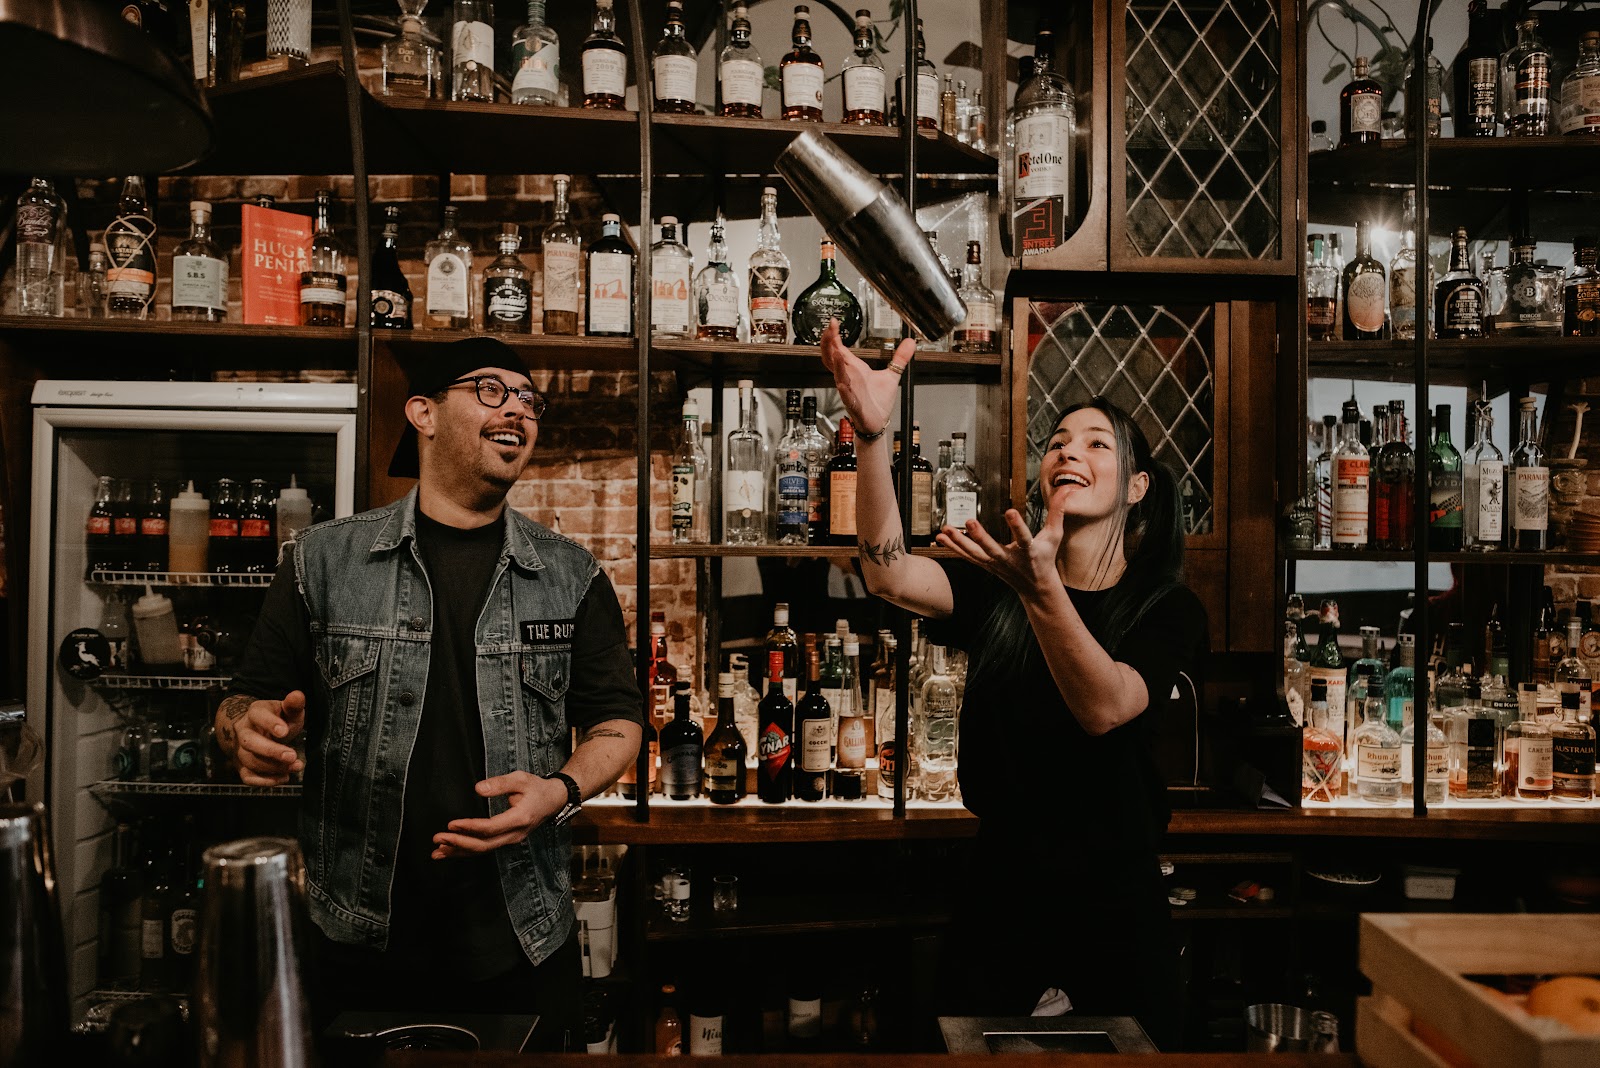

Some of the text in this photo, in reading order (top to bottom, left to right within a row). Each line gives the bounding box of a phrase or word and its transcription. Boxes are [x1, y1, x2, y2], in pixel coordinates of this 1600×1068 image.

[398, 47, 415, 55] Don
[596, 63, 615, 71] 2009
[1044, 152, 1063, 165] One
[526, 624, 550, 640] THE
[760, 735, 790, 760] CYNAR
[1367, 752, 1389, 760] Rhum
